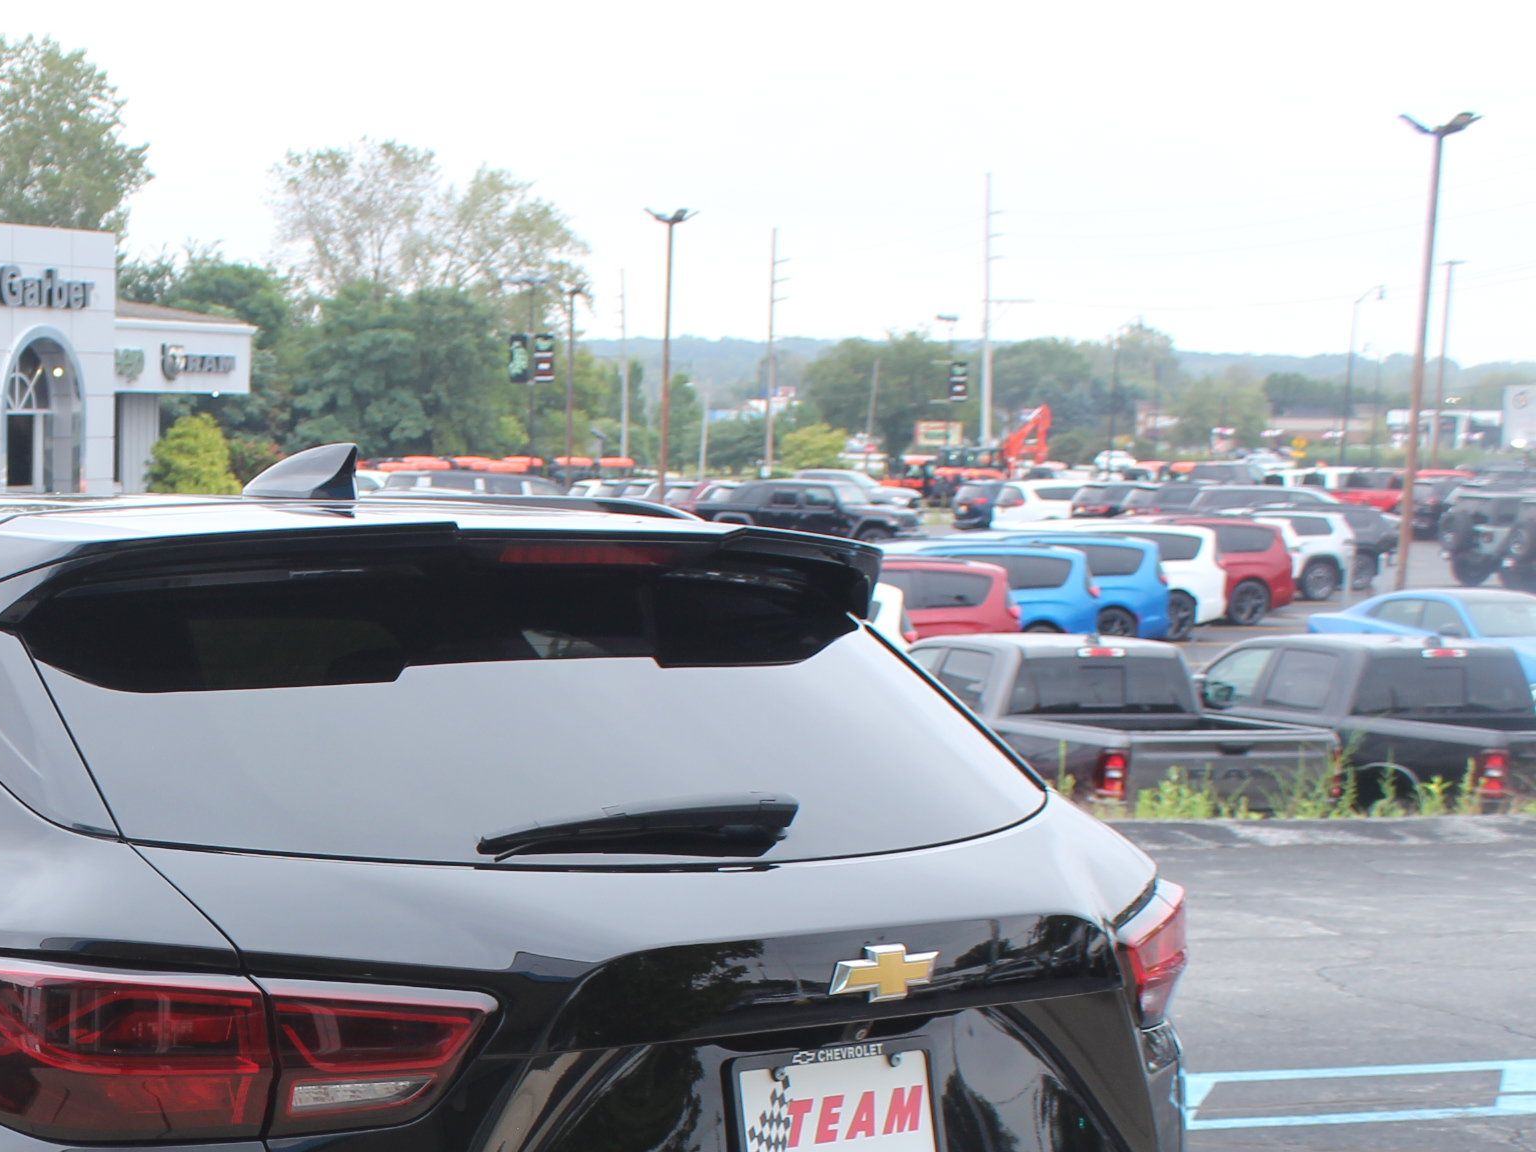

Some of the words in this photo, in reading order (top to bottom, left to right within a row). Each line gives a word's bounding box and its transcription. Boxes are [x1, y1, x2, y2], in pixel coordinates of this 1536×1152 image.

[185, 354, 236, 374] RAM
[817, 1043, 884, 1062] CHEVROLET
[786, 1084, 924, 1149] TEAM
